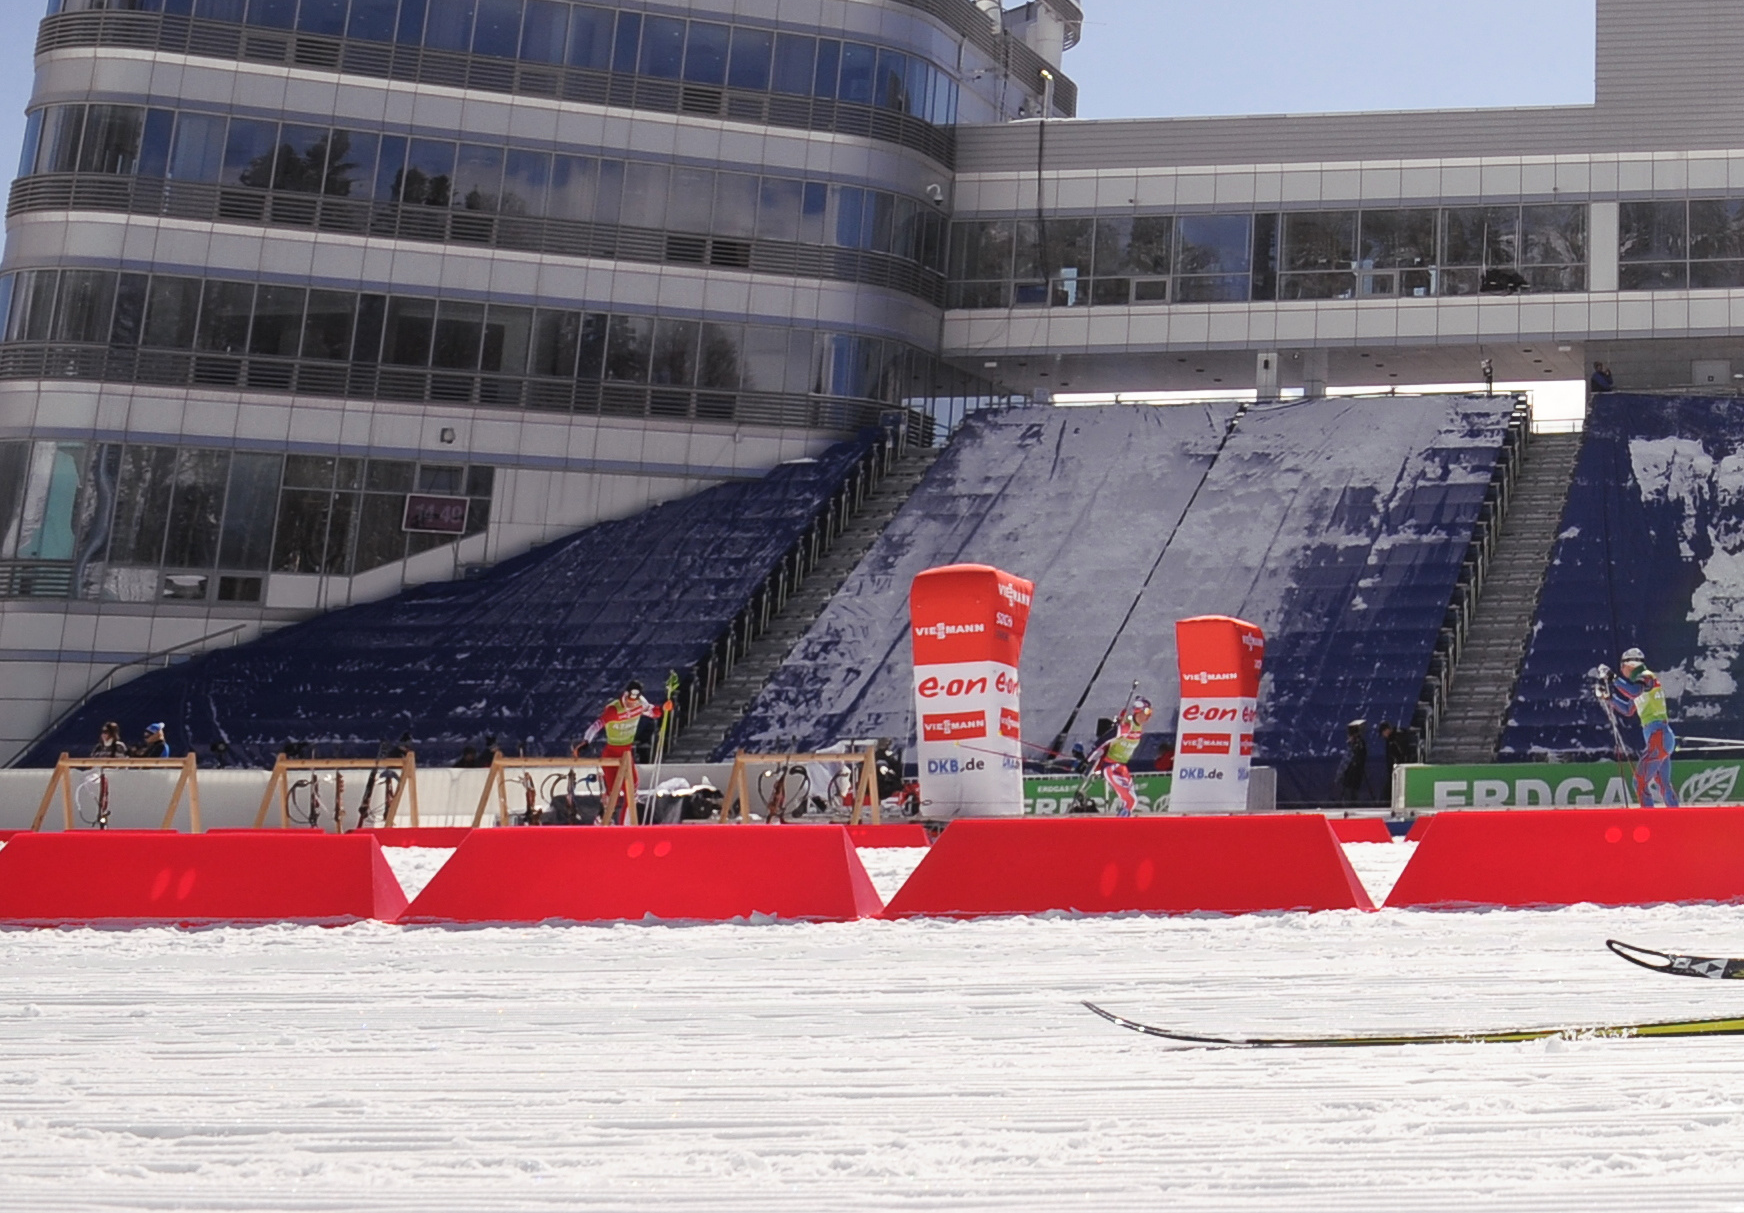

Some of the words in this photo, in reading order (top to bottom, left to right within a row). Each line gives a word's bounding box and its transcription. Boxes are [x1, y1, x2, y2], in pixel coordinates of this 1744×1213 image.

[914, 622, 985, 640] VIESSMANN
[927, 756, 985, 775] DKB.de
[1179, 768, 1224, 781] DKB.de
